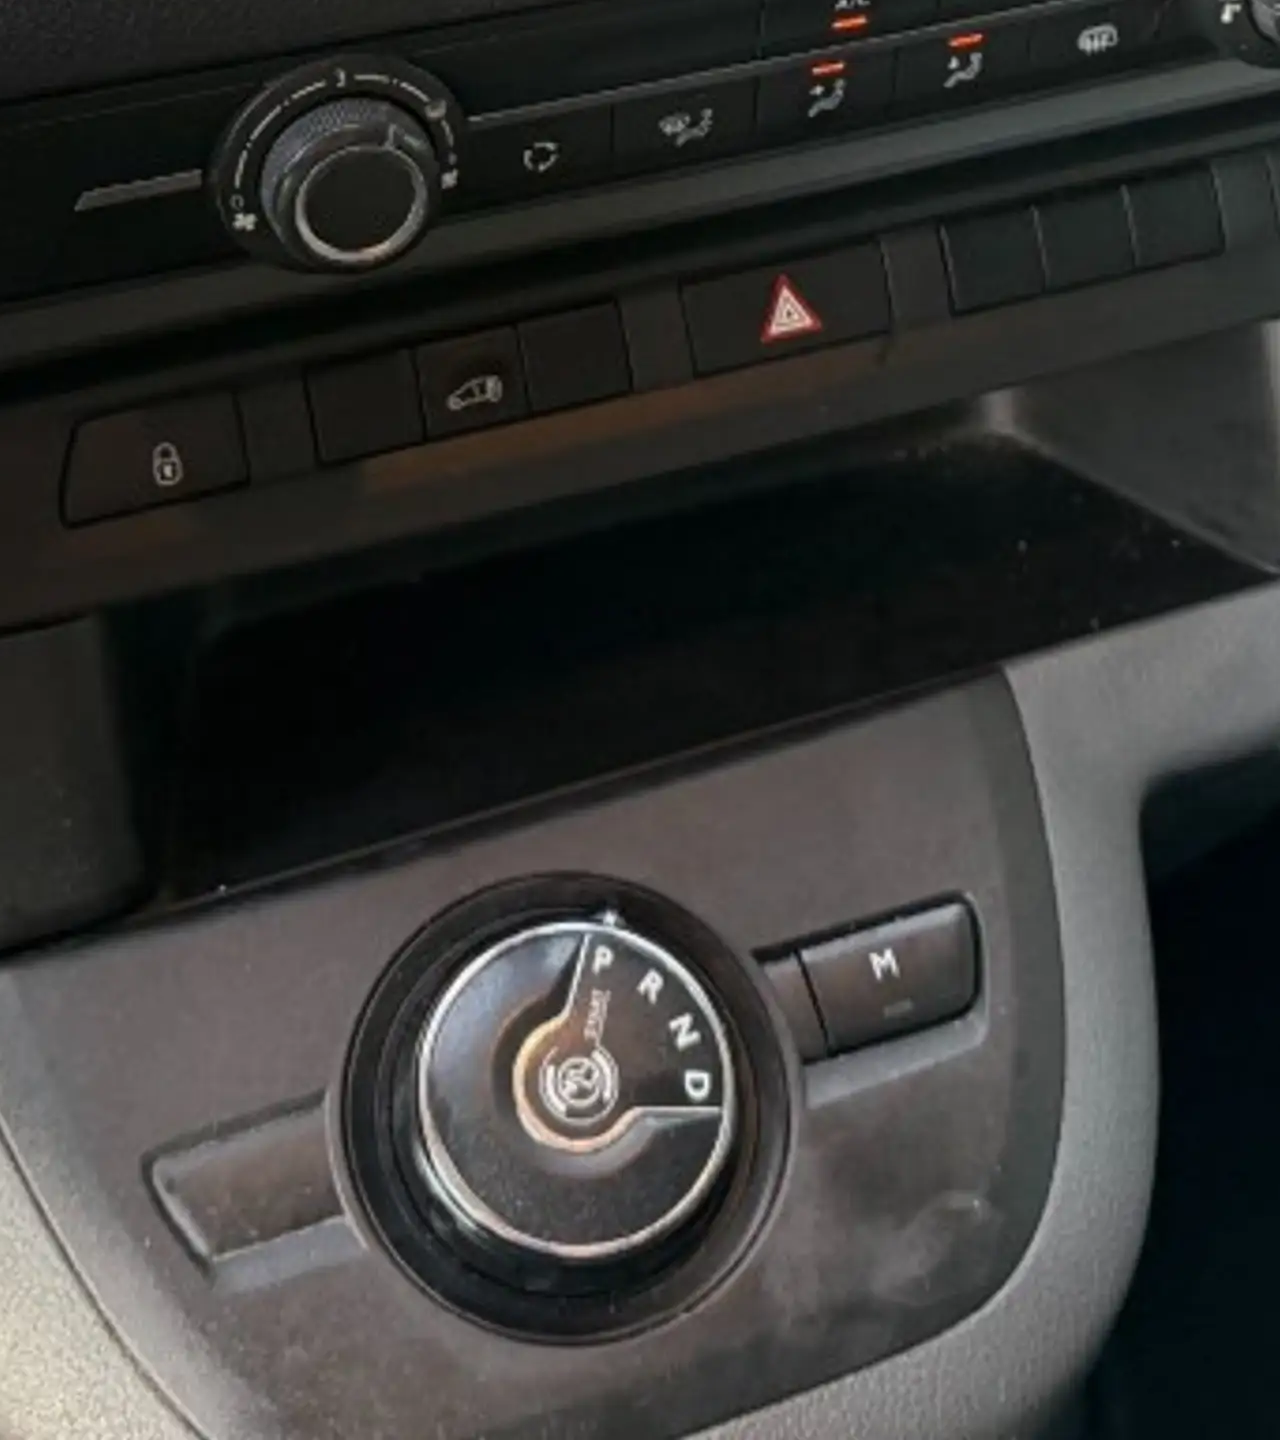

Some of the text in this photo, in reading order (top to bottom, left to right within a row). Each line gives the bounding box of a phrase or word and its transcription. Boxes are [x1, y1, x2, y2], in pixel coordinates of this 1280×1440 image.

[592, 945, 614, 976] P
[868, 947, 900, 981] M
[637, 969, 664, 1004] R
[669, 1013, 701, 1050] N
[684, 1070, 711, 1102] D
